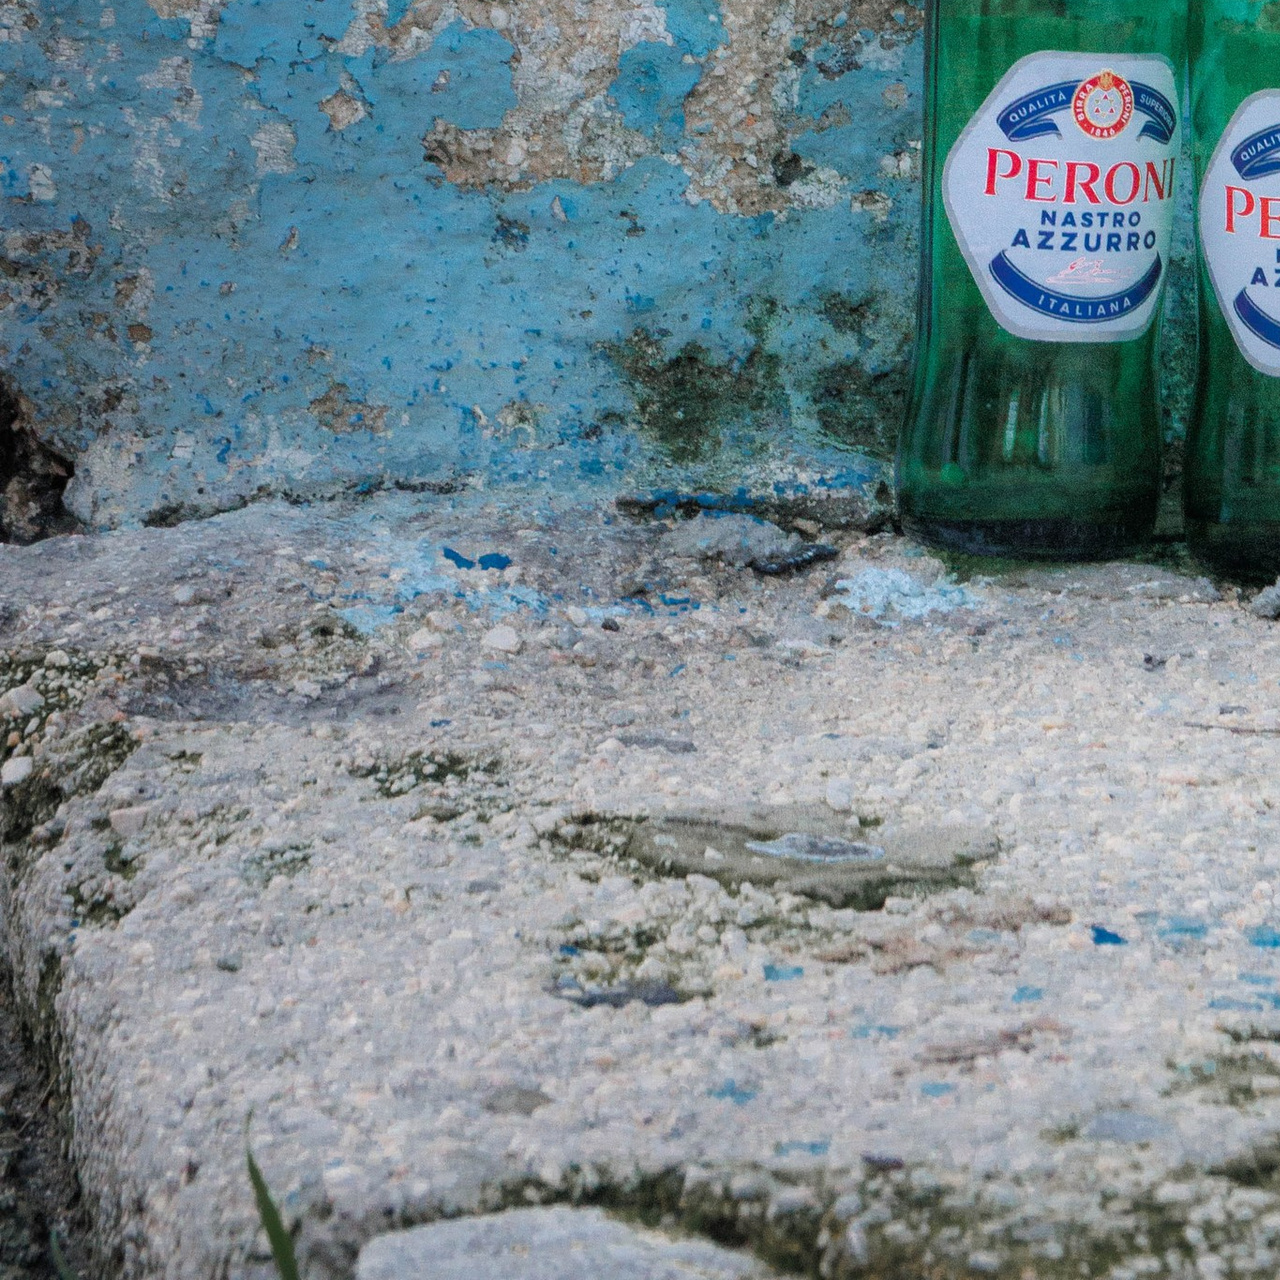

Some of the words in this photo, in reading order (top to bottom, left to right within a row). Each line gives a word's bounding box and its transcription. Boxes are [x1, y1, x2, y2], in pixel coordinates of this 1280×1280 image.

[1009, 91, 1066, 123] QUALITÀ
[1076, 83, 1094, 121] BIRRA
[1119, 83, 1132, 124] PERONI
[1090, 127, 1116, 138] 1846
[983, 147, 1175, 206] PERONI
[1040, 209, 1141, 228] NASTRO
[1011, 228, 1156, 252] AZZURRO
[1038, 294, 1132, 317] ITALIANA
